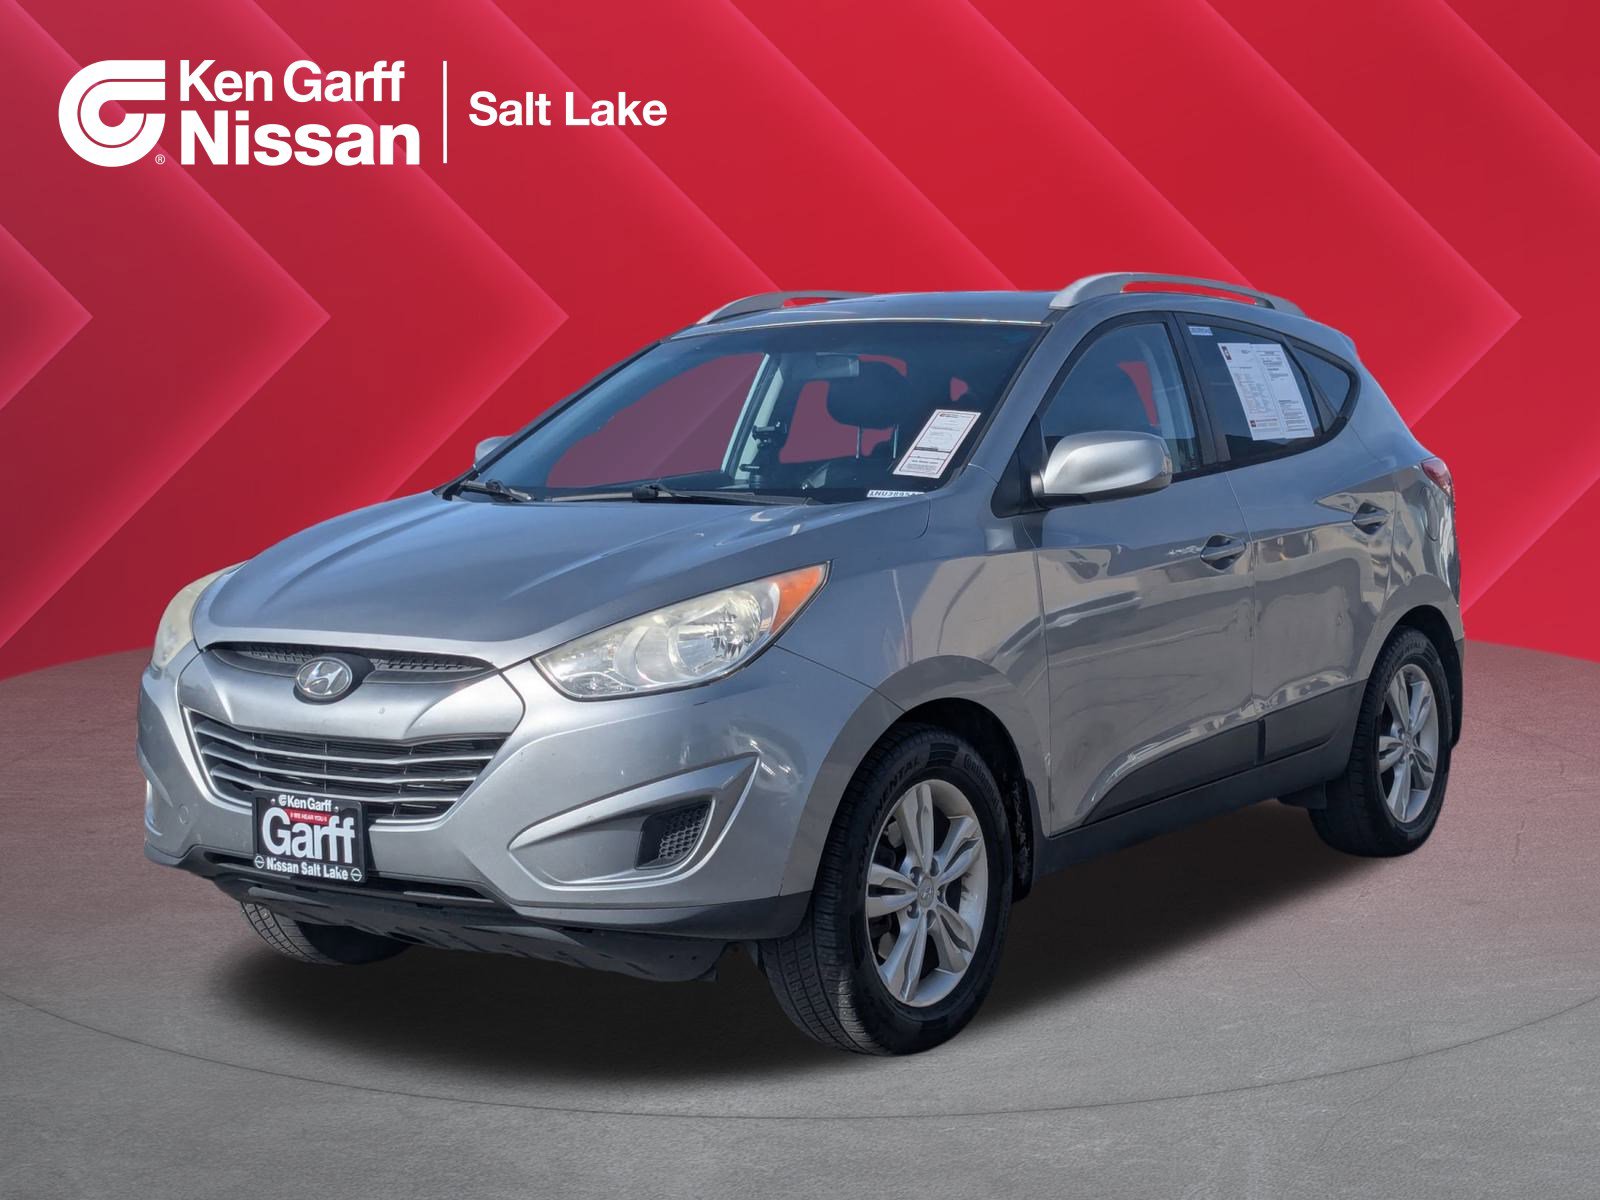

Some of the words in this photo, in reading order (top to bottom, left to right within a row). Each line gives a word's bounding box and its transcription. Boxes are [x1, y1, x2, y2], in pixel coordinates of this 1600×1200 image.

[287, 795, 306, 810] Ken
[307, 797, 332, 812] Garff
[262, 807, 355, 864] Garff
[266, 857, 299, 874] Nissan
[301, 862, 321, 877] Salt
[323, 866, 348, 880] Lake
